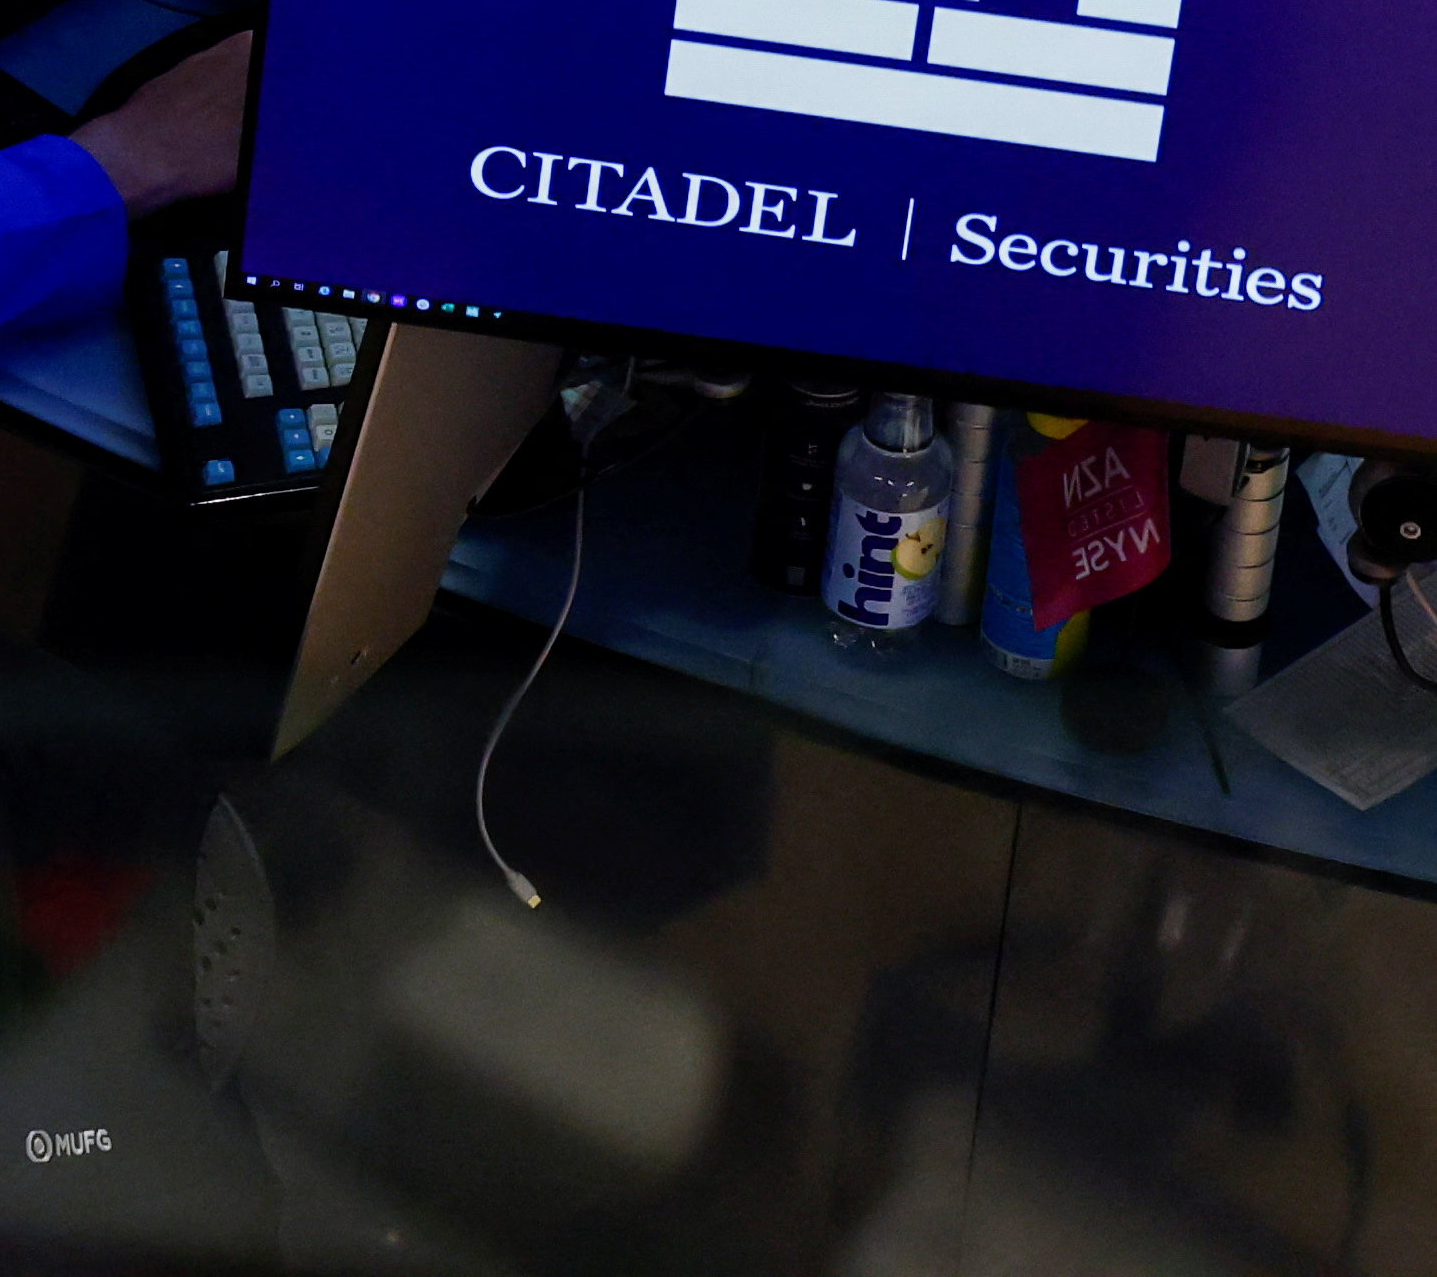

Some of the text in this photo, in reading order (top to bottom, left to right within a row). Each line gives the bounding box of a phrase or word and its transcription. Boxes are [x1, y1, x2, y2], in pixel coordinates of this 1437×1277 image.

[468, 144, 1324, 313] CITADEL Securities
[837, 510, 903, 627] hint
[55, 1129, 112, 1156] MUFG
